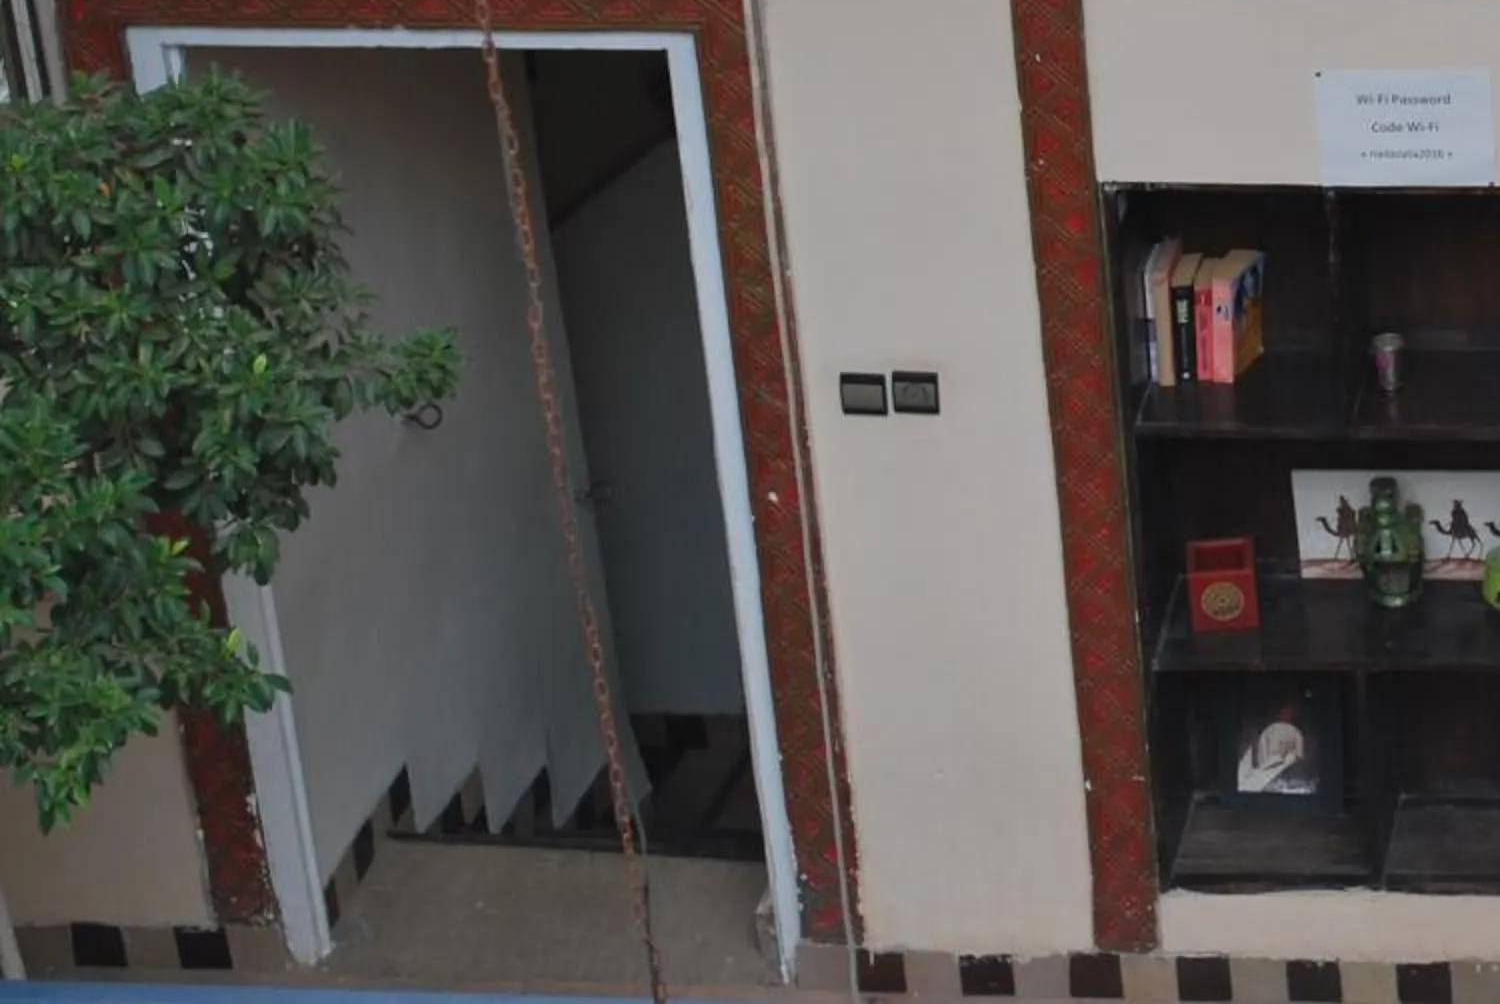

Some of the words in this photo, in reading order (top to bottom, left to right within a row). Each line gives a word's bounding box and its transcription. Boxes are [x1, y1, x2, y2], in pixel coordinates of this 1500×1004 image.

[1356, 93, 1389, 106] Wi-Fi
[1391, 93, 1451, 106] Password
[1371, 121, 1403, 133] Code
[1407, 121, 1439, 133] Wi-Fi
